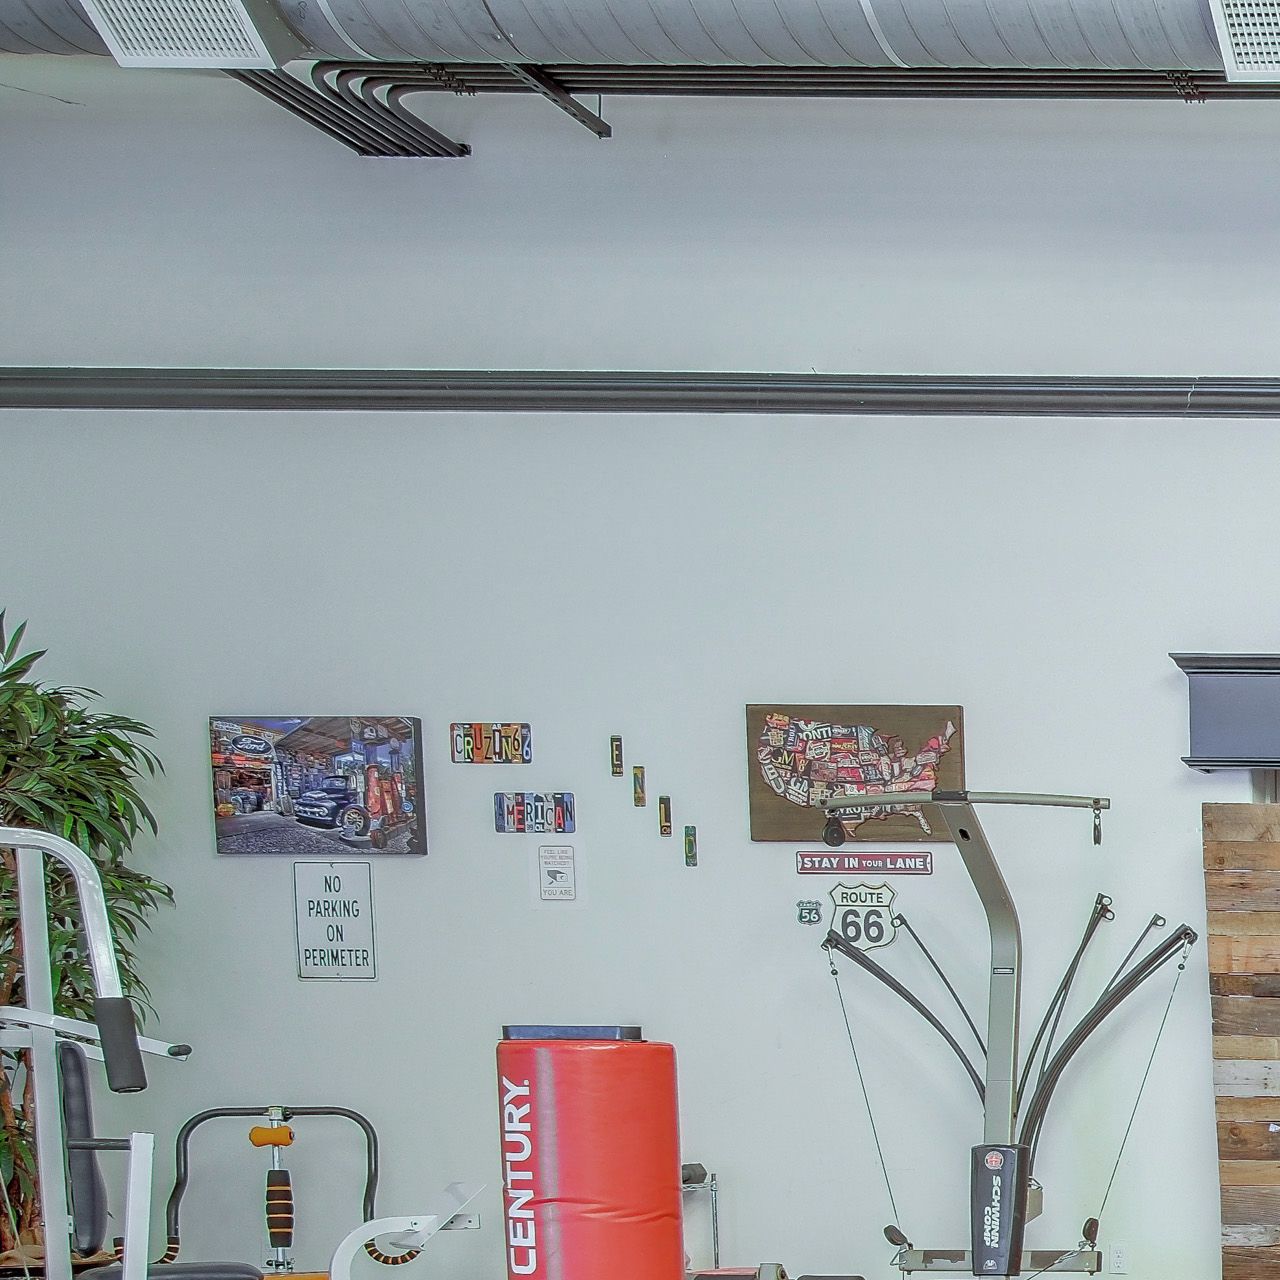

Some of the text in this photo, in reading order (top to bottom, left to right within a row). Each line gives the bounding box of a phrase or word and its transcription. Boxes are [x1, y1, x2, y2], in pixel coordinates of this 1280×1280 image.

[236, 737, 266, 751] Ford
[613, 742, 621, 764] E
[496, 800, 574, 830] AMERICAN
[660, 804, 670, 825] L
[804, 858, 840, 868] STAY
[844, 858, 859, 868] IN
[887, 858, 924, 869] LANE
[324, 876, 341, 893] NO
[841, 892, 883, 903] ROUTE
[308, 900, 360, 918] PARKING
[801, 910, 819, 921] 56
[327, 924, 344, 942] ON
[841, 908, 884, 943] 66
[304, 949, 370, 967] PERIMETER
[991, 1175, 1001, 1248] SCHWINN
[983, 1206, 992, 1247] COMP
